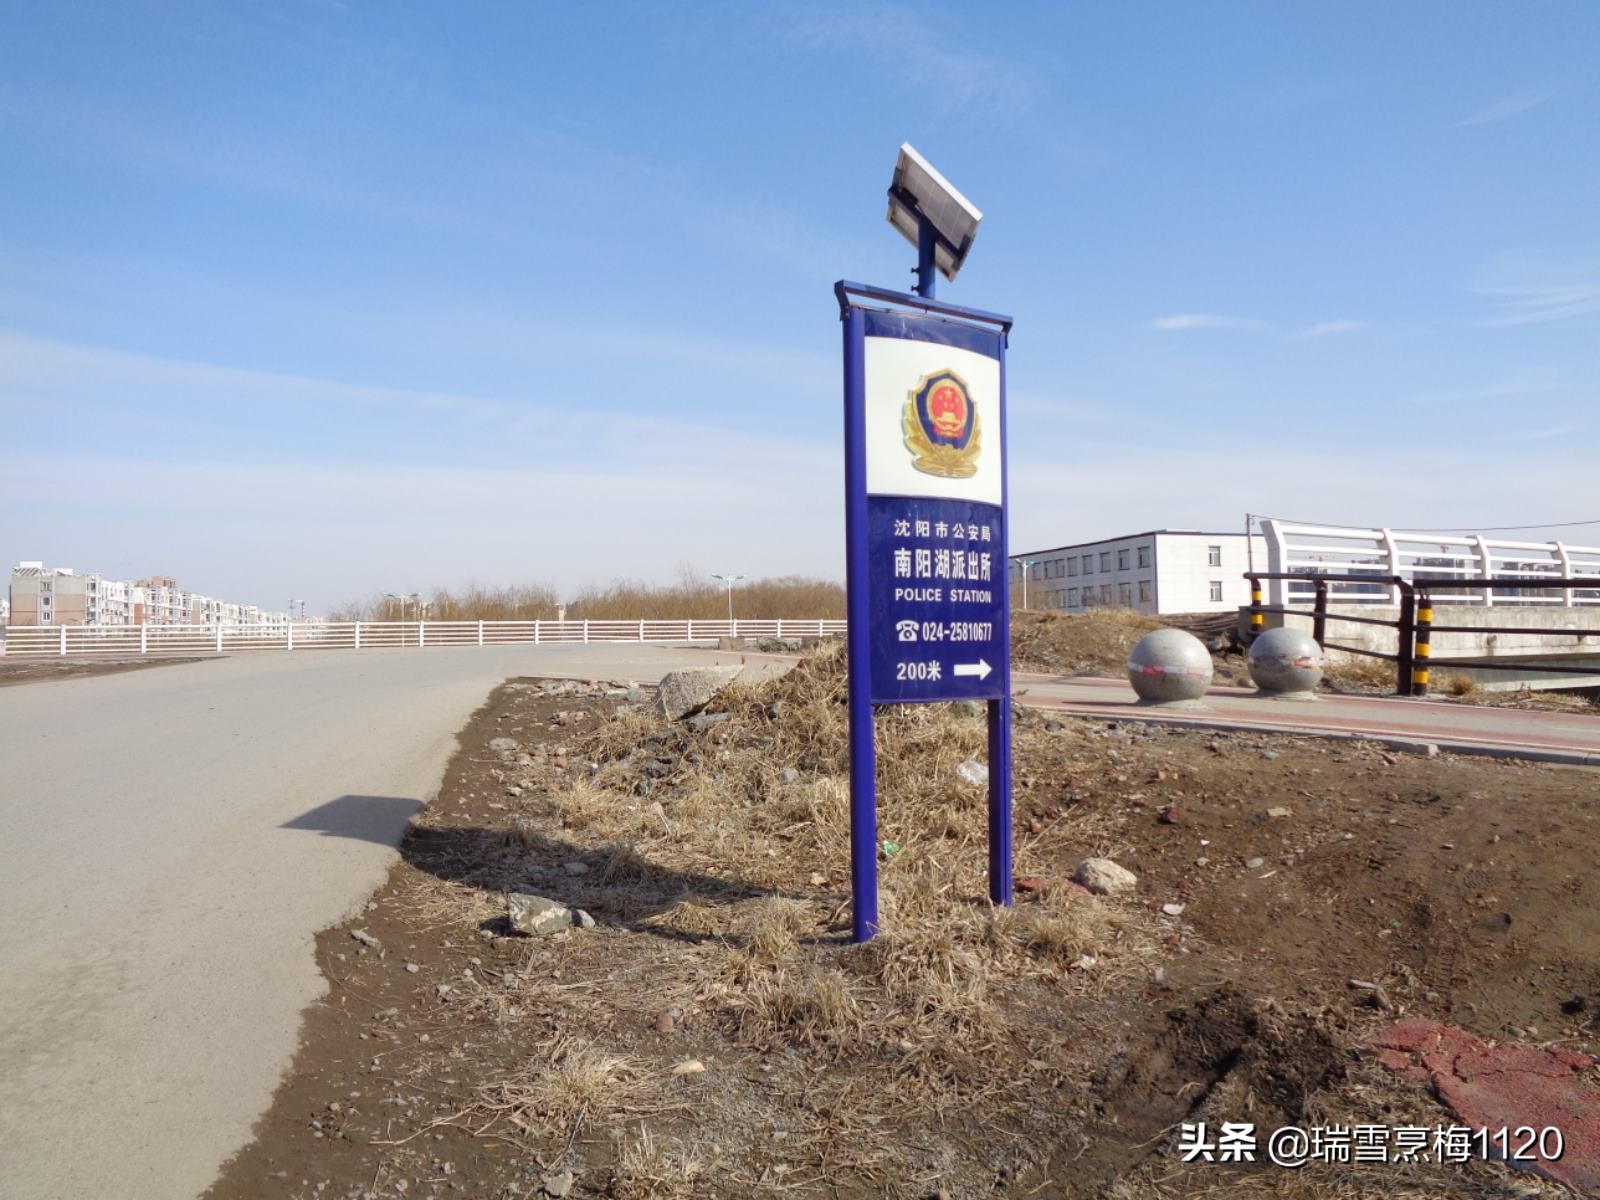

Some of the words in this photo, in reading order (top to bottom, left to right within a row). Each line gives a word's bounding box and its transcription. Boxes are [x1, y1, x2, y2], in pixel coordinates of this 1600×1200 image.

[894, 519, 990, 542] 沈阳市公安局
[894, 547, 991, 582] 南阳湖派出所
[895, 588, 942, 601] POLICE
[950, 589, 991, 603] STATION
[922, 622, 992, 641] 024-25810677
[896, 660, 942, 681] 200米
